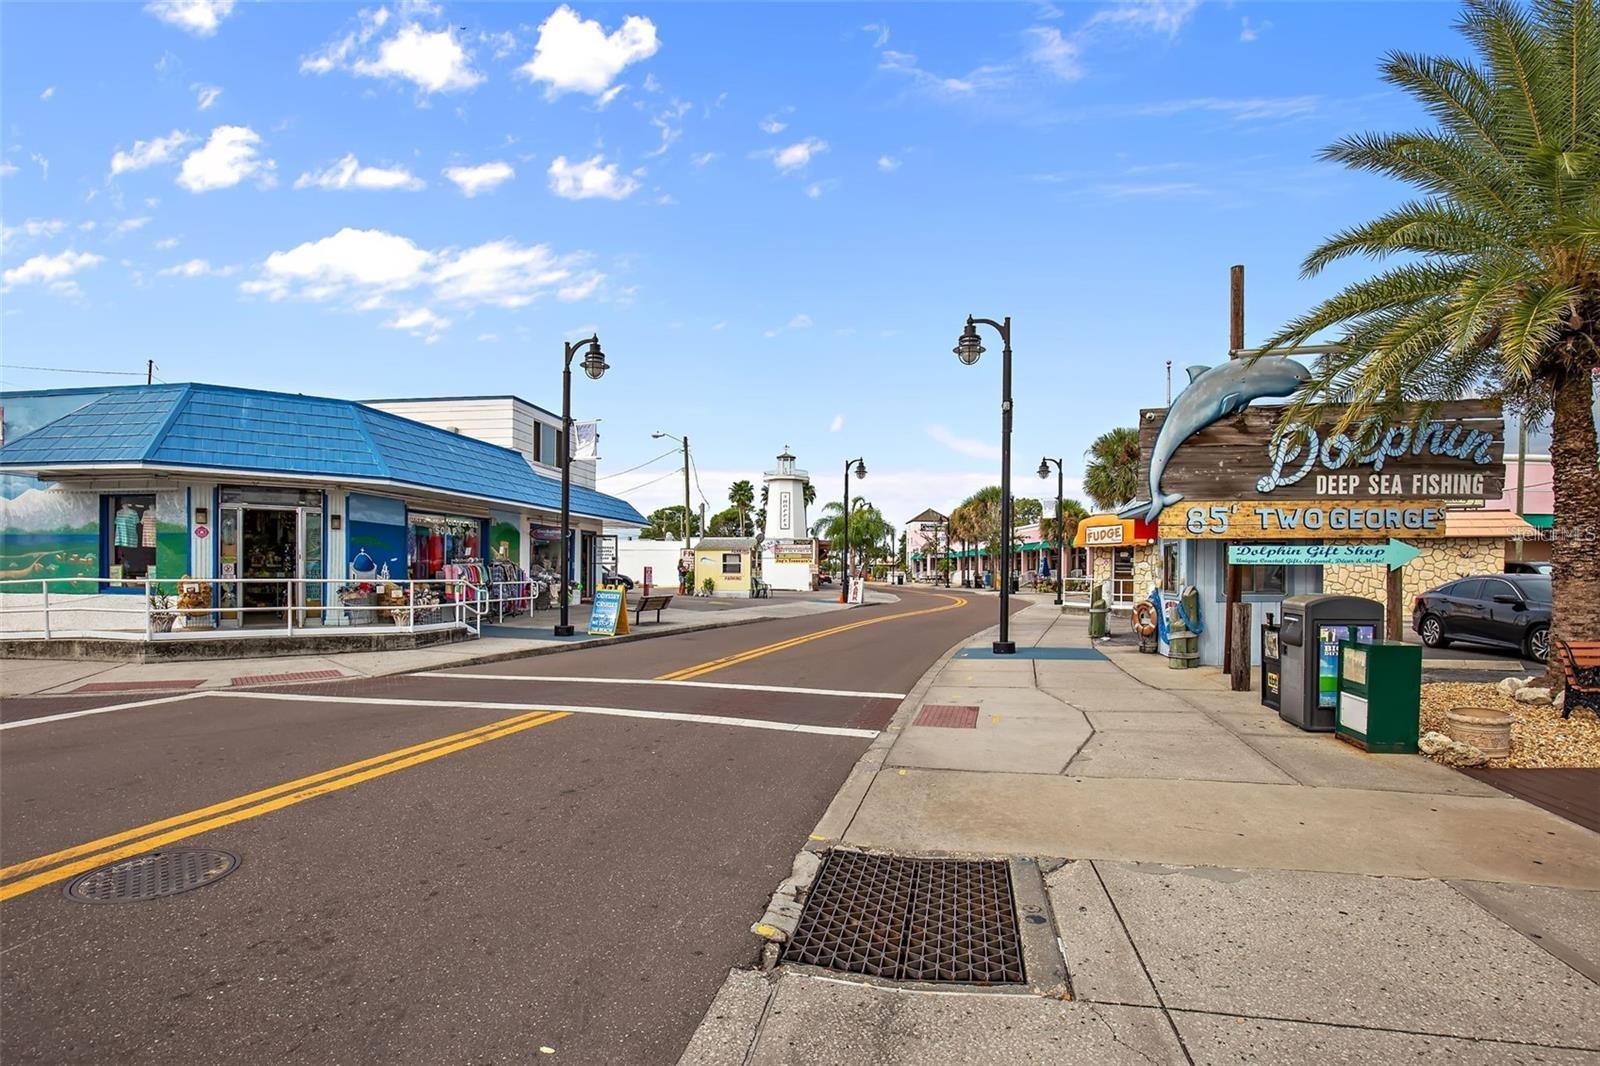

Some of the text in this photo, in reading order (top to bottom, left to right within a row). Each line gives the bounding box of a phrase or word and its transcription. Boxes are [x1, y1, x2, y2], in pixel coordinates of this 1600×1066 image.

[1256, 421, 1494, 494] Dolphin
[1316, 472, 1484, 496] DEEP SEA FISHING
[1186, 504, 1239, 533] 85'
[1254, 507, 1323, 529] TWO
[435, 526, 457, 536] SOAP
[1088, 527, 1122, 542] FUDGE
[1236, 545, 1386, 558] Dolphin Gift Shop
